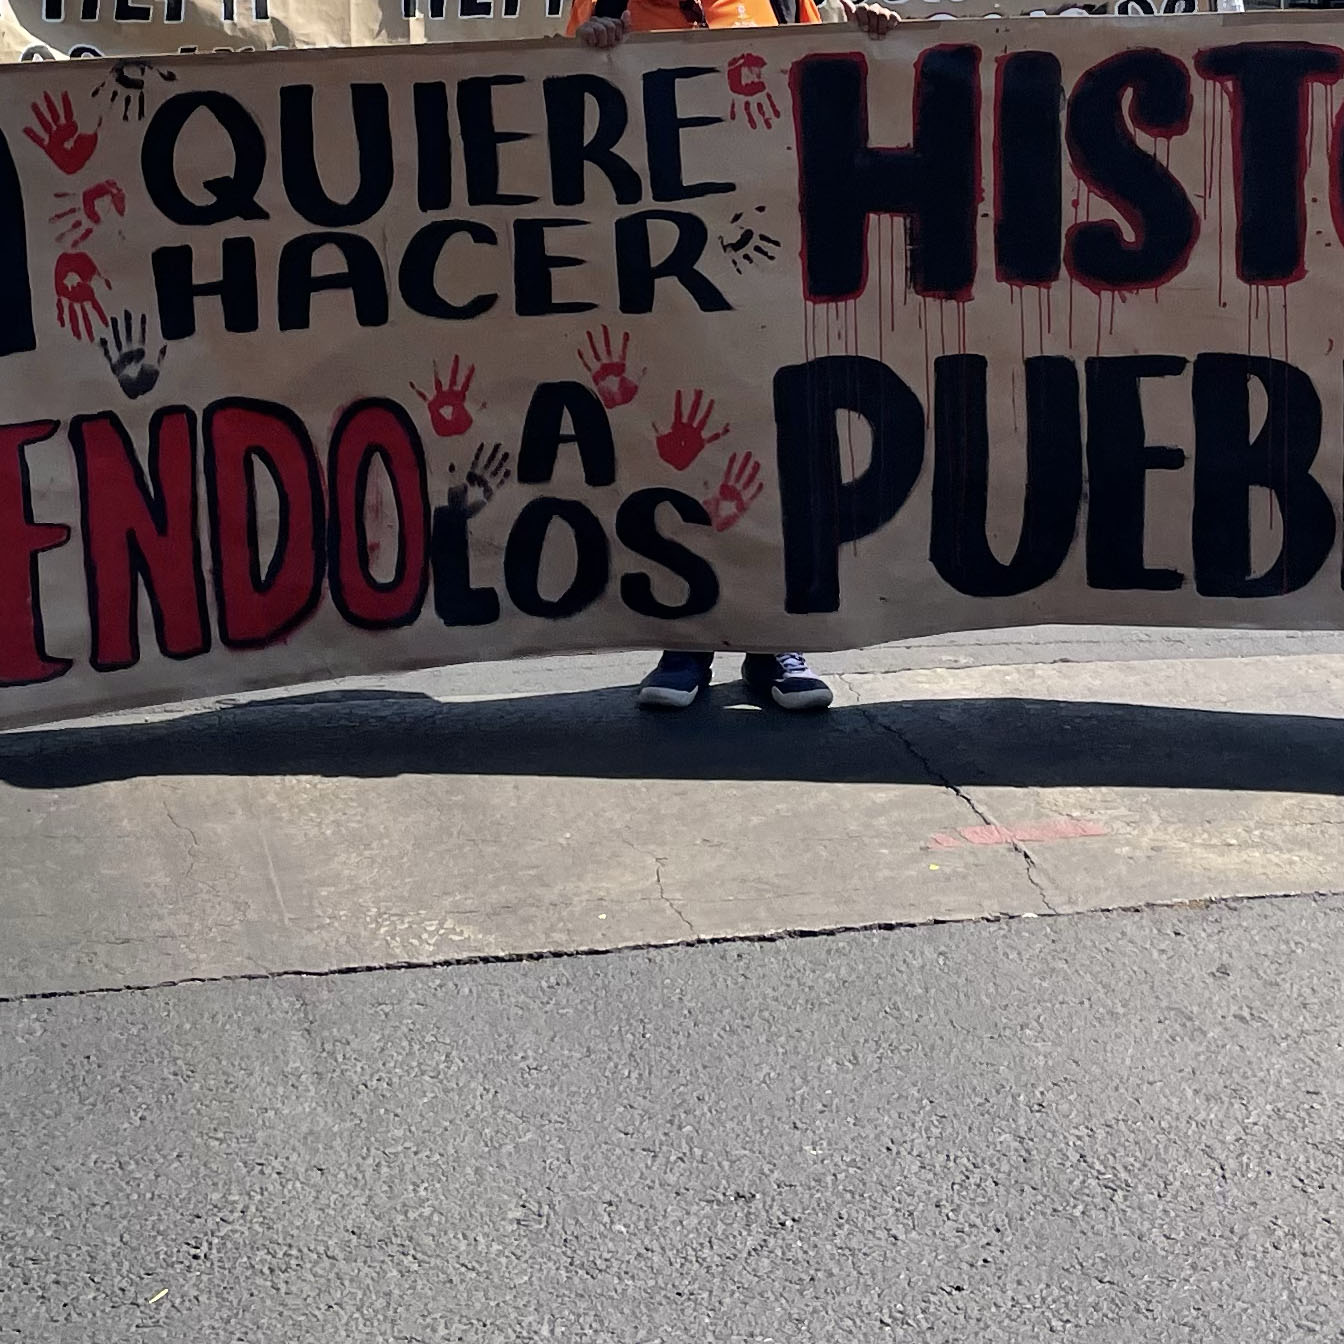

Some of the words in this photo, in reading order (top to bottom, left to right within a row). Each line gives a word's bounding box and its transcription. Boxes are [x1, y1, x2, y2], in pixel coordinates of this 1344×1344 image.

[141, 65, 737, 228] QUIERE
[152, 210, 733, 341] HACER
[516, 381, 617, 487] A
[431, 487, 721, 628] LOS
